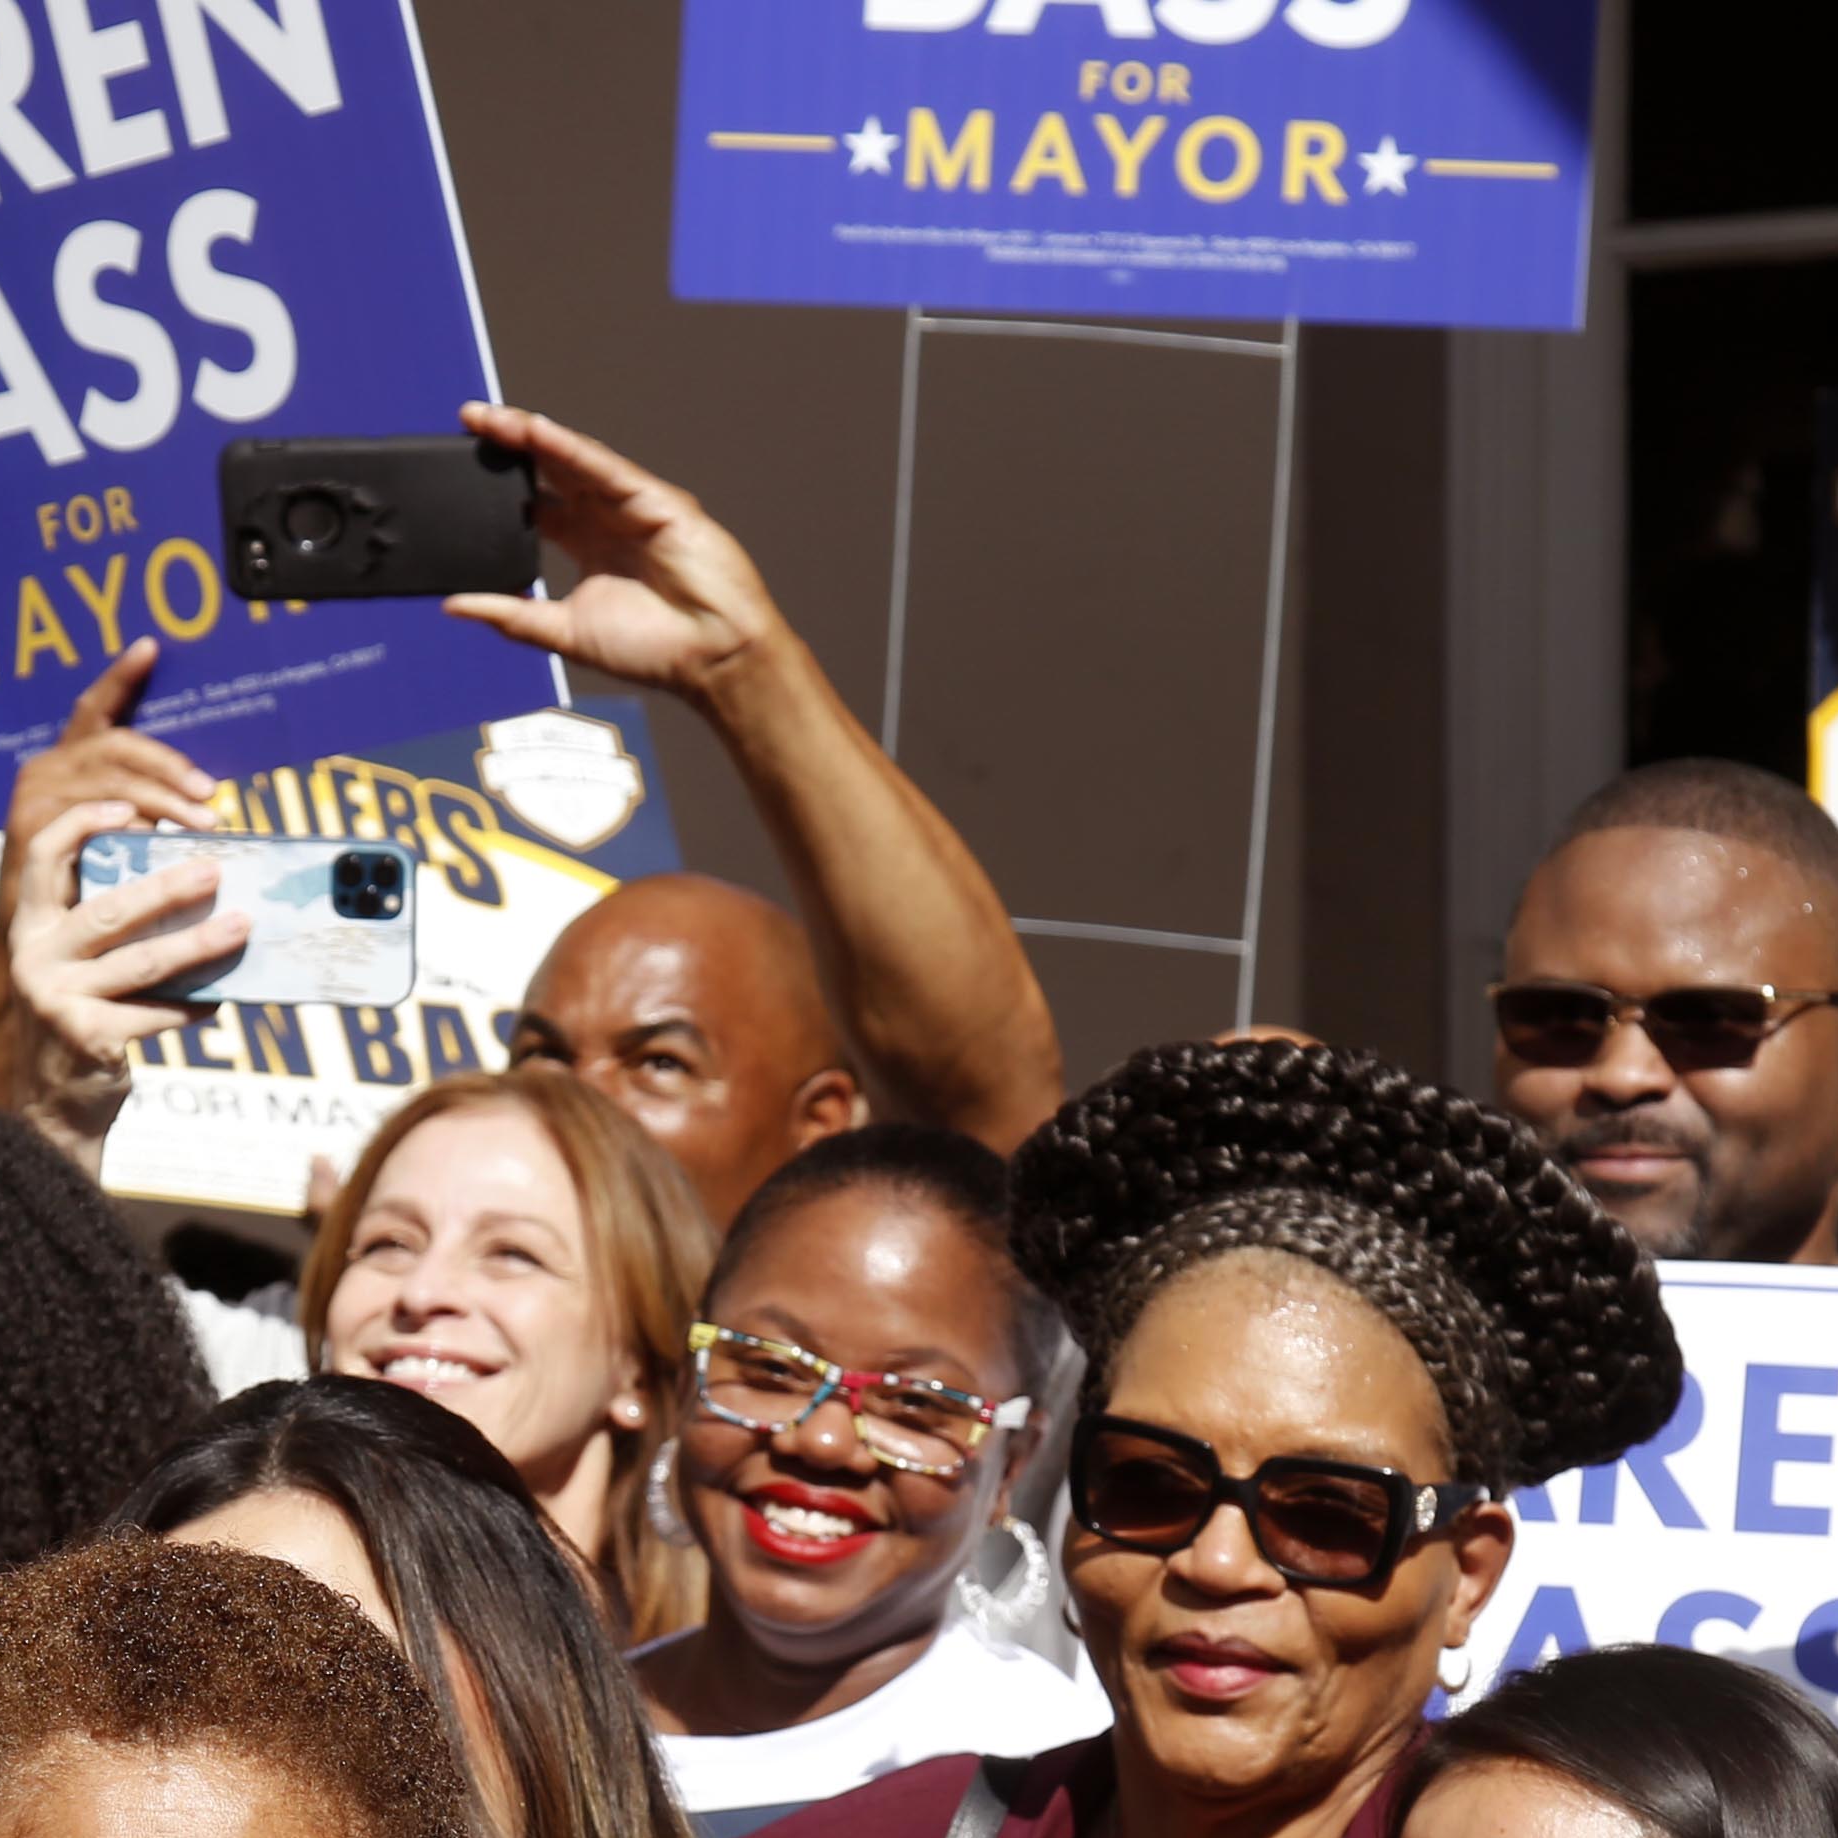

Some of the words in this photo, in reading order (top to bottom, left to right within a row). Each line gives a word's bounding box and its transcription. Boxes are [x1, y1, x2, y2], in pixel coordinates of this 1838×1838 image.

[1079, 60, 1192, 104] FOR
[903, 107, 1349, 205] MAYOR
[37, 485, 139, 550] FOR
